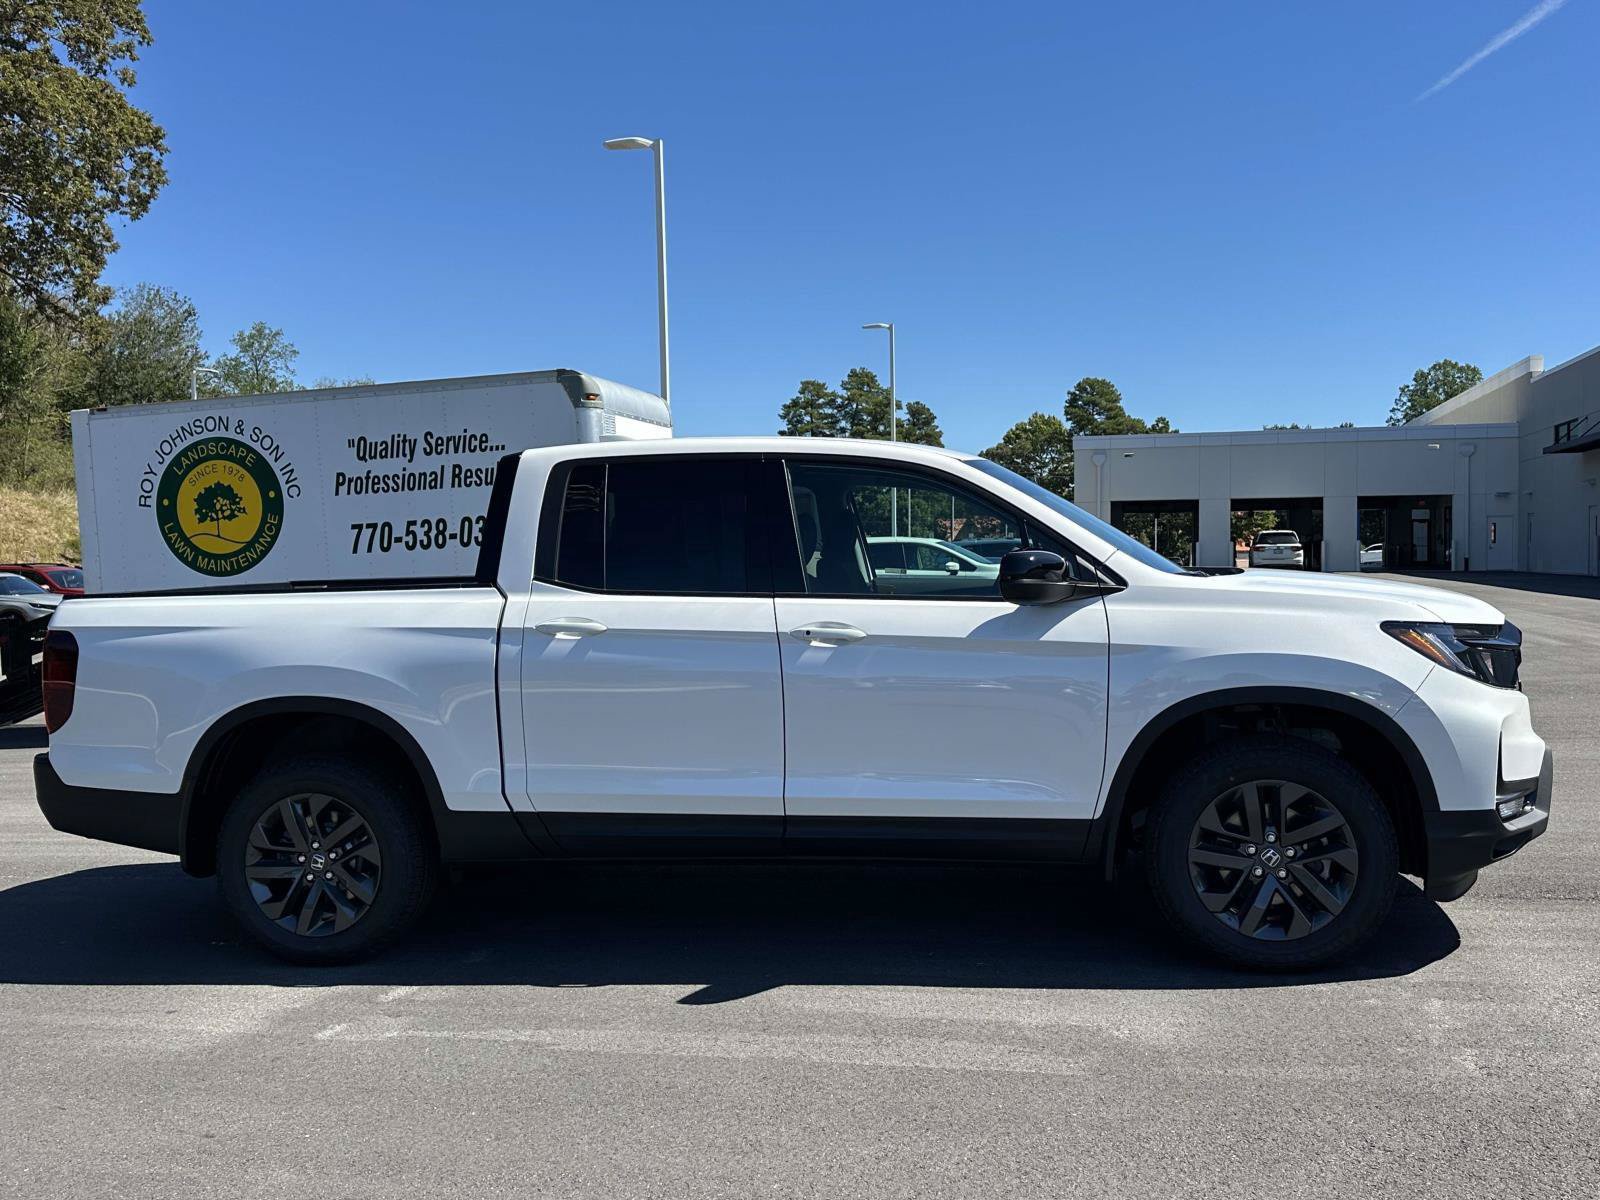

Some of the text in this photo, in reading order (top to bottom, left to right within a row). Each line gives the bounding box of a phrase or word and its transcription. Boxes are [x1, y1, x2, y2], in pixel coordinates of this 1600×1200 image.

[138, 415, 301, 508] ROY JOHNSON & SON INC
[172, 442, 256, 475] LANDSCAPE
[347, 428, 506, 463] "Quality Service...
[188, 464, 246, 487] SINCE 1978
[334, 464, 445, 496] Professional
[164, 512, 279, 572] LAWN MAINTENANCE
